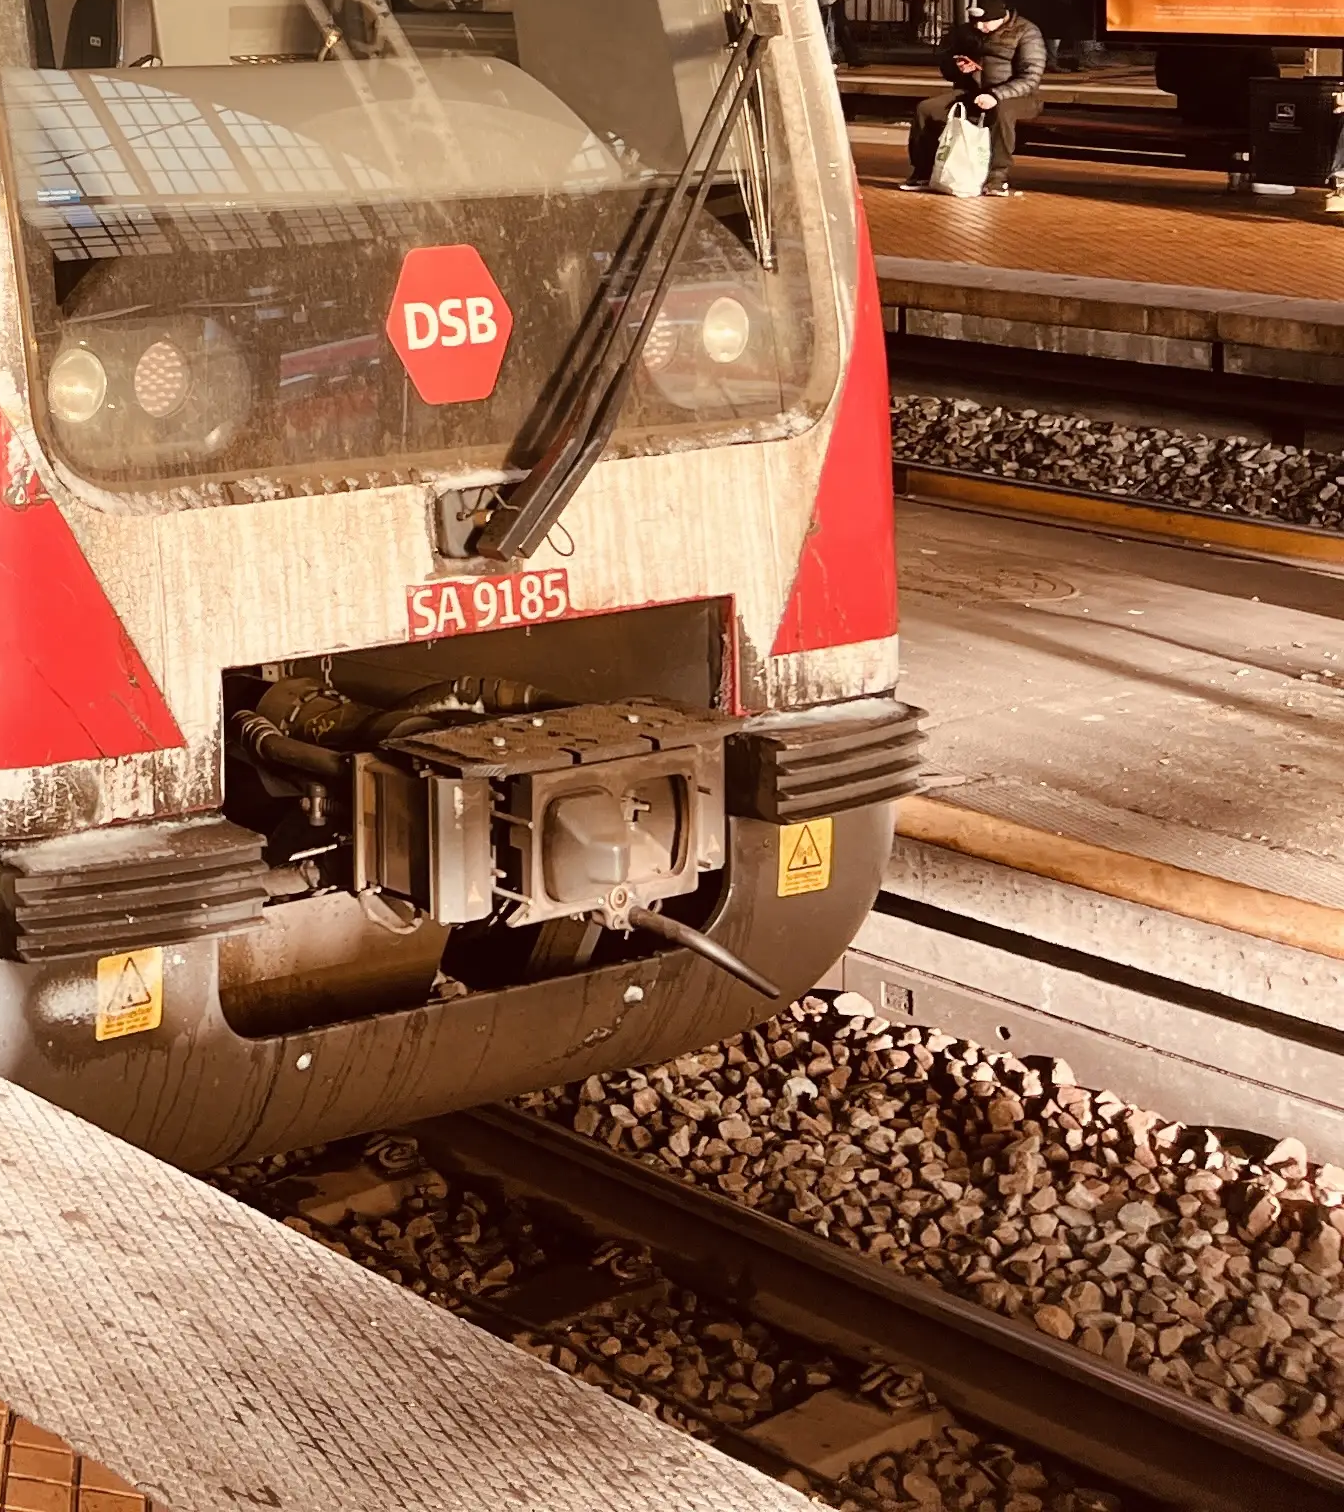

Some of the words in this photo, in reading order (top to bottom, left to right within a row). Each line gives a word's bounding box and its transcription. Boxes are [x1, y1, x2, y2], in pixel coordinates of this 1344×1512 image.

[403, 297, 497, 351] DSB
[412, 586, 465, 637] SA
[473, 573, 567, 629] 9185
